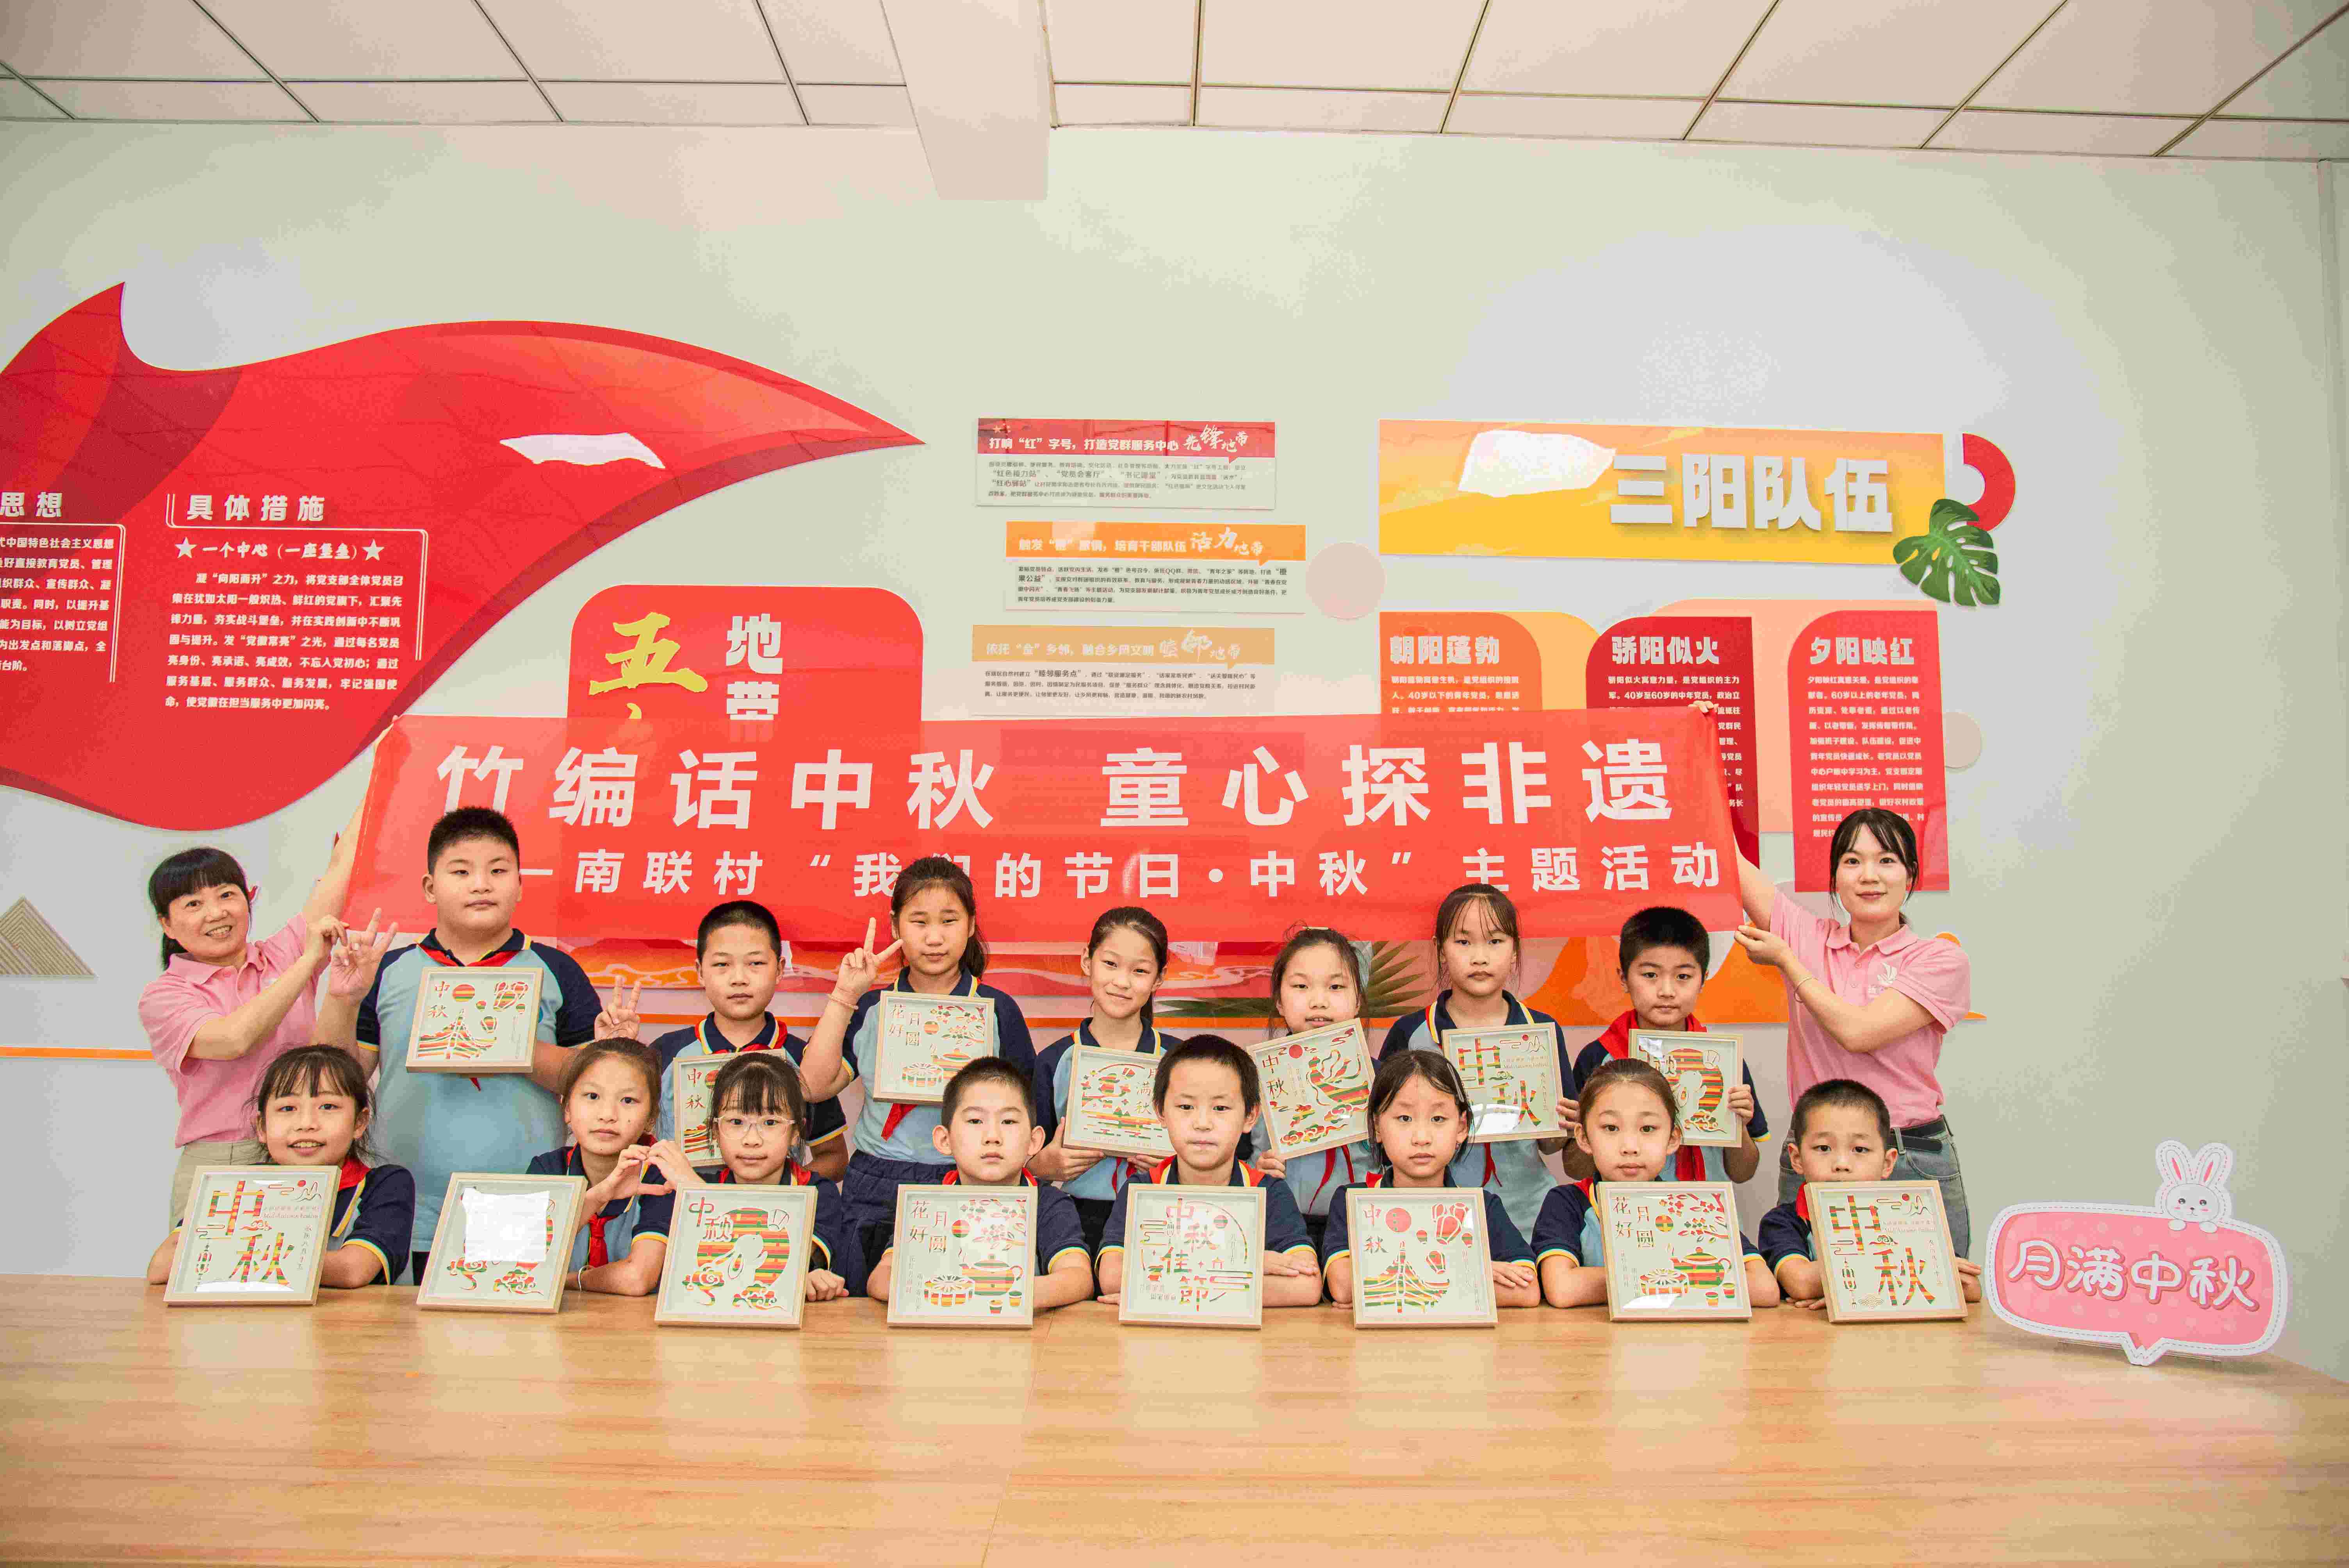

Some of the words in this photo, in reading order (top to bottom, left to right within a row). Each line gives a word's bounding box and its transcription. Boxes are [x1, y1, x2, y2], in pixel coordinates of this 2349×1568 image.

[1183, 424, 1249, 452] 先锋地带
[0, 492, 62, 518] 思想
[1610, 454, 1893, 533] 三阳队伍
[187, 495, 325, 522] 具体措施
[1190, 526, 1264, 556] 活力地带
[0, 558, 113, 570] 好直接教育党员、管理
[0, 578, 111, 590] 织群众、宣传群众、凝
[1390, 636, 1499, 664] 朝阳蓬勃
[1612, 636, 1719, 665] 骄阳似火
[1810, 637, 1914, 665] 夕阳映红
[0, 660, 28, 672] 台阶。
[589, 612, 708, 719] 五
[437, 745, 994, 830] 竹编话中秋
[1100, 738, 1673, 828] 童心探非遗
[2008, 1240, 2257, 1310] 月满中秋
